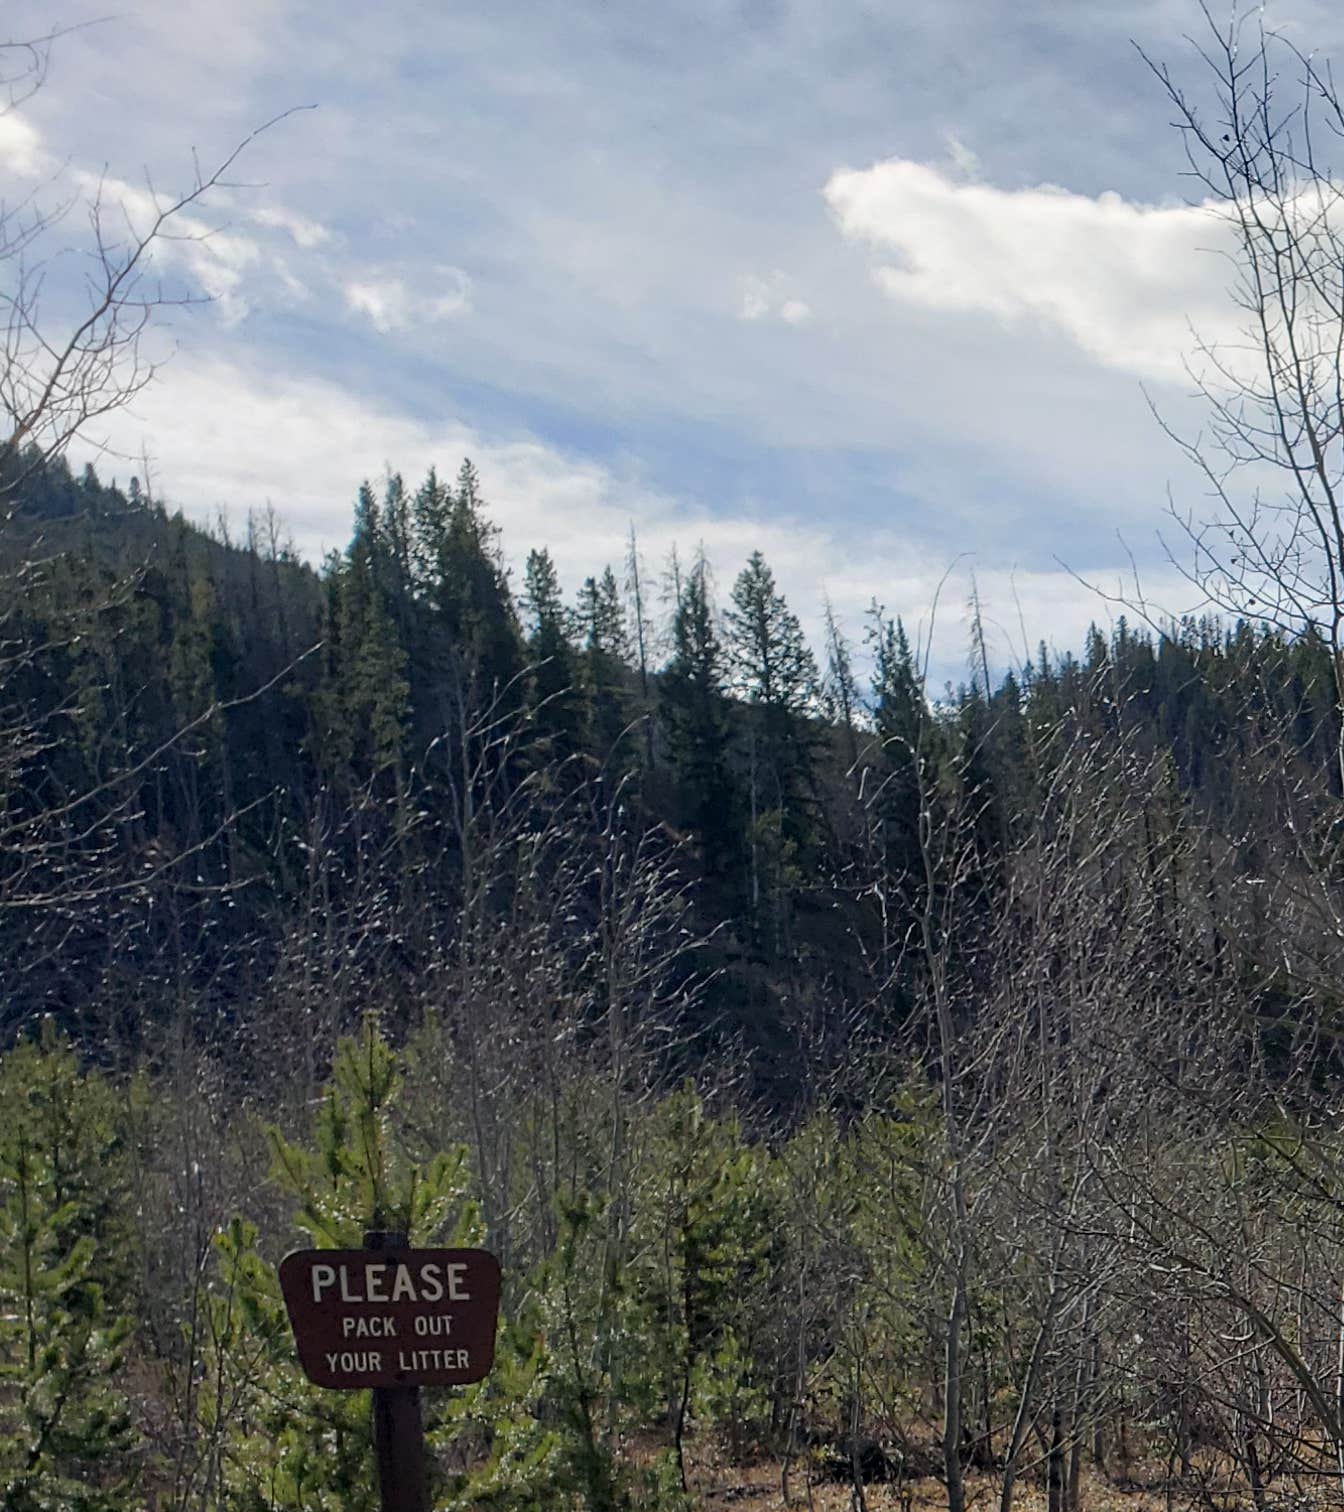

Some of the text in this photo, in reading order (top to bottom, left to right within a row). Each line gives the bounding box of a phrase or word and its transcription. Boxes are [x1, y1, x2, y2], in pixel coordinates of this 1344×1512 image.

[311, 1263, 470, 1302] PLEASE
[342, 1315, 453, 1338] PACK OUT
[326, 1350, 469, 1373] YOUR LITTER
